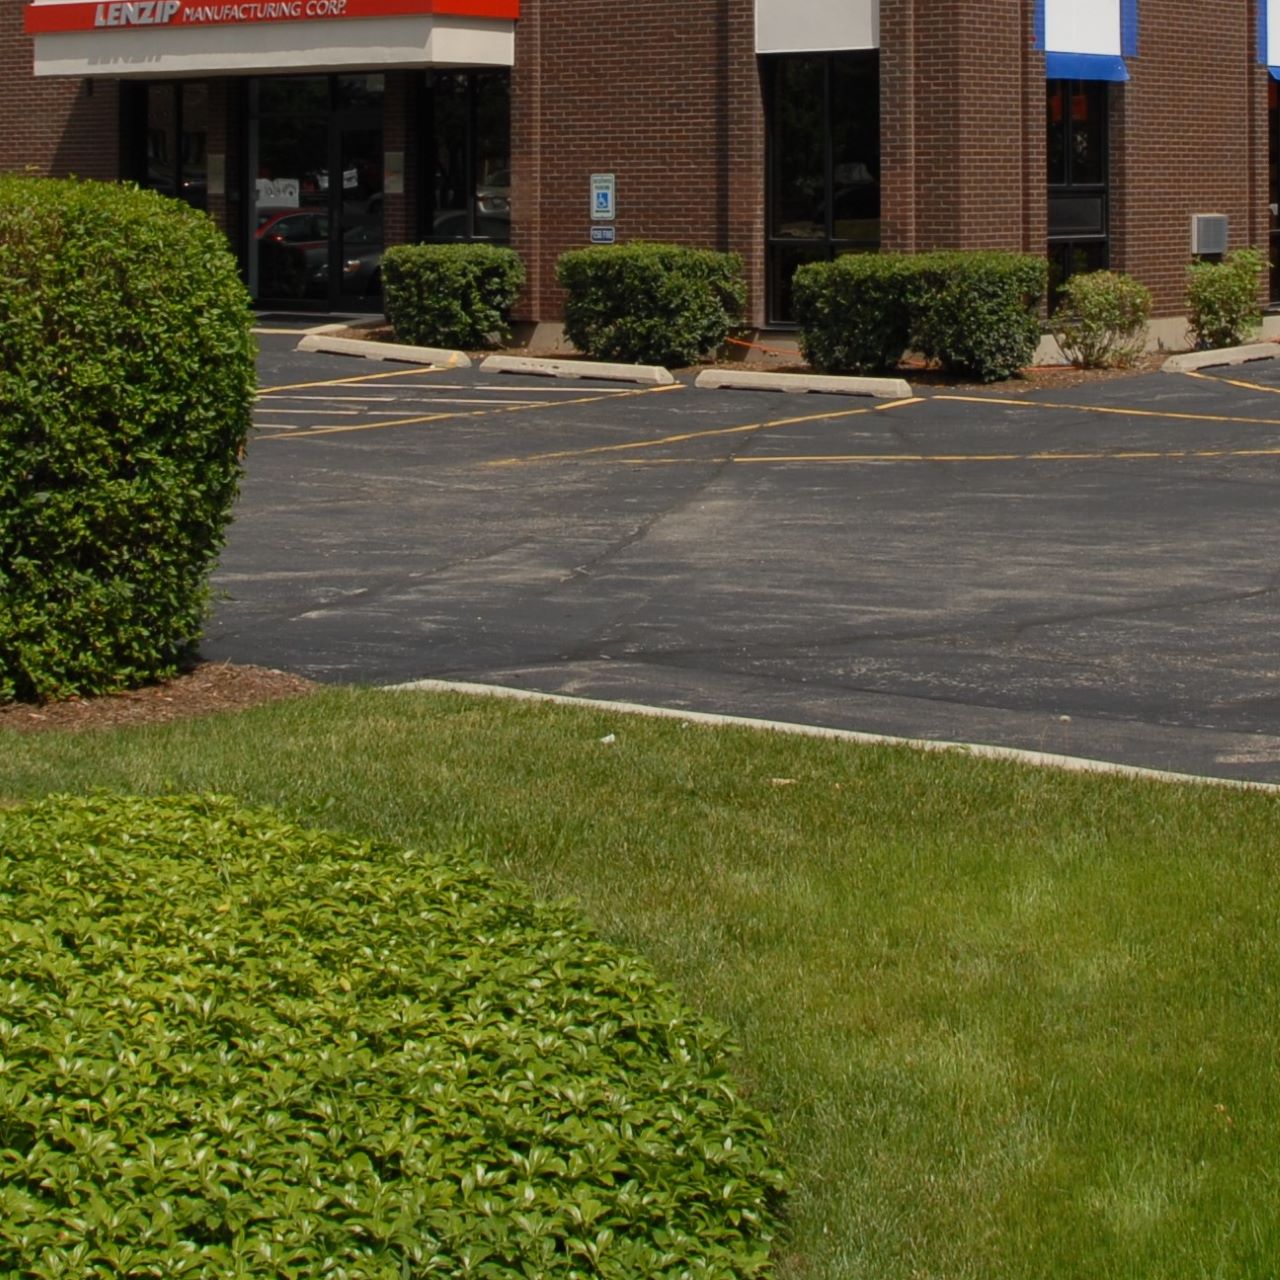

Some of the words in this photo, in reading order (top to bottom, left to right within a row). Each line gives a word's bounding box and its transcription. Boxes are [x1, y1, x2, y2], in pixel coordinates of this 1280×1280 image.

[94, 0, 181, 27] LENZIP
[183, 2, 301, 21] MANUFACTURING
[306, 0, 346, 16] CORP.
